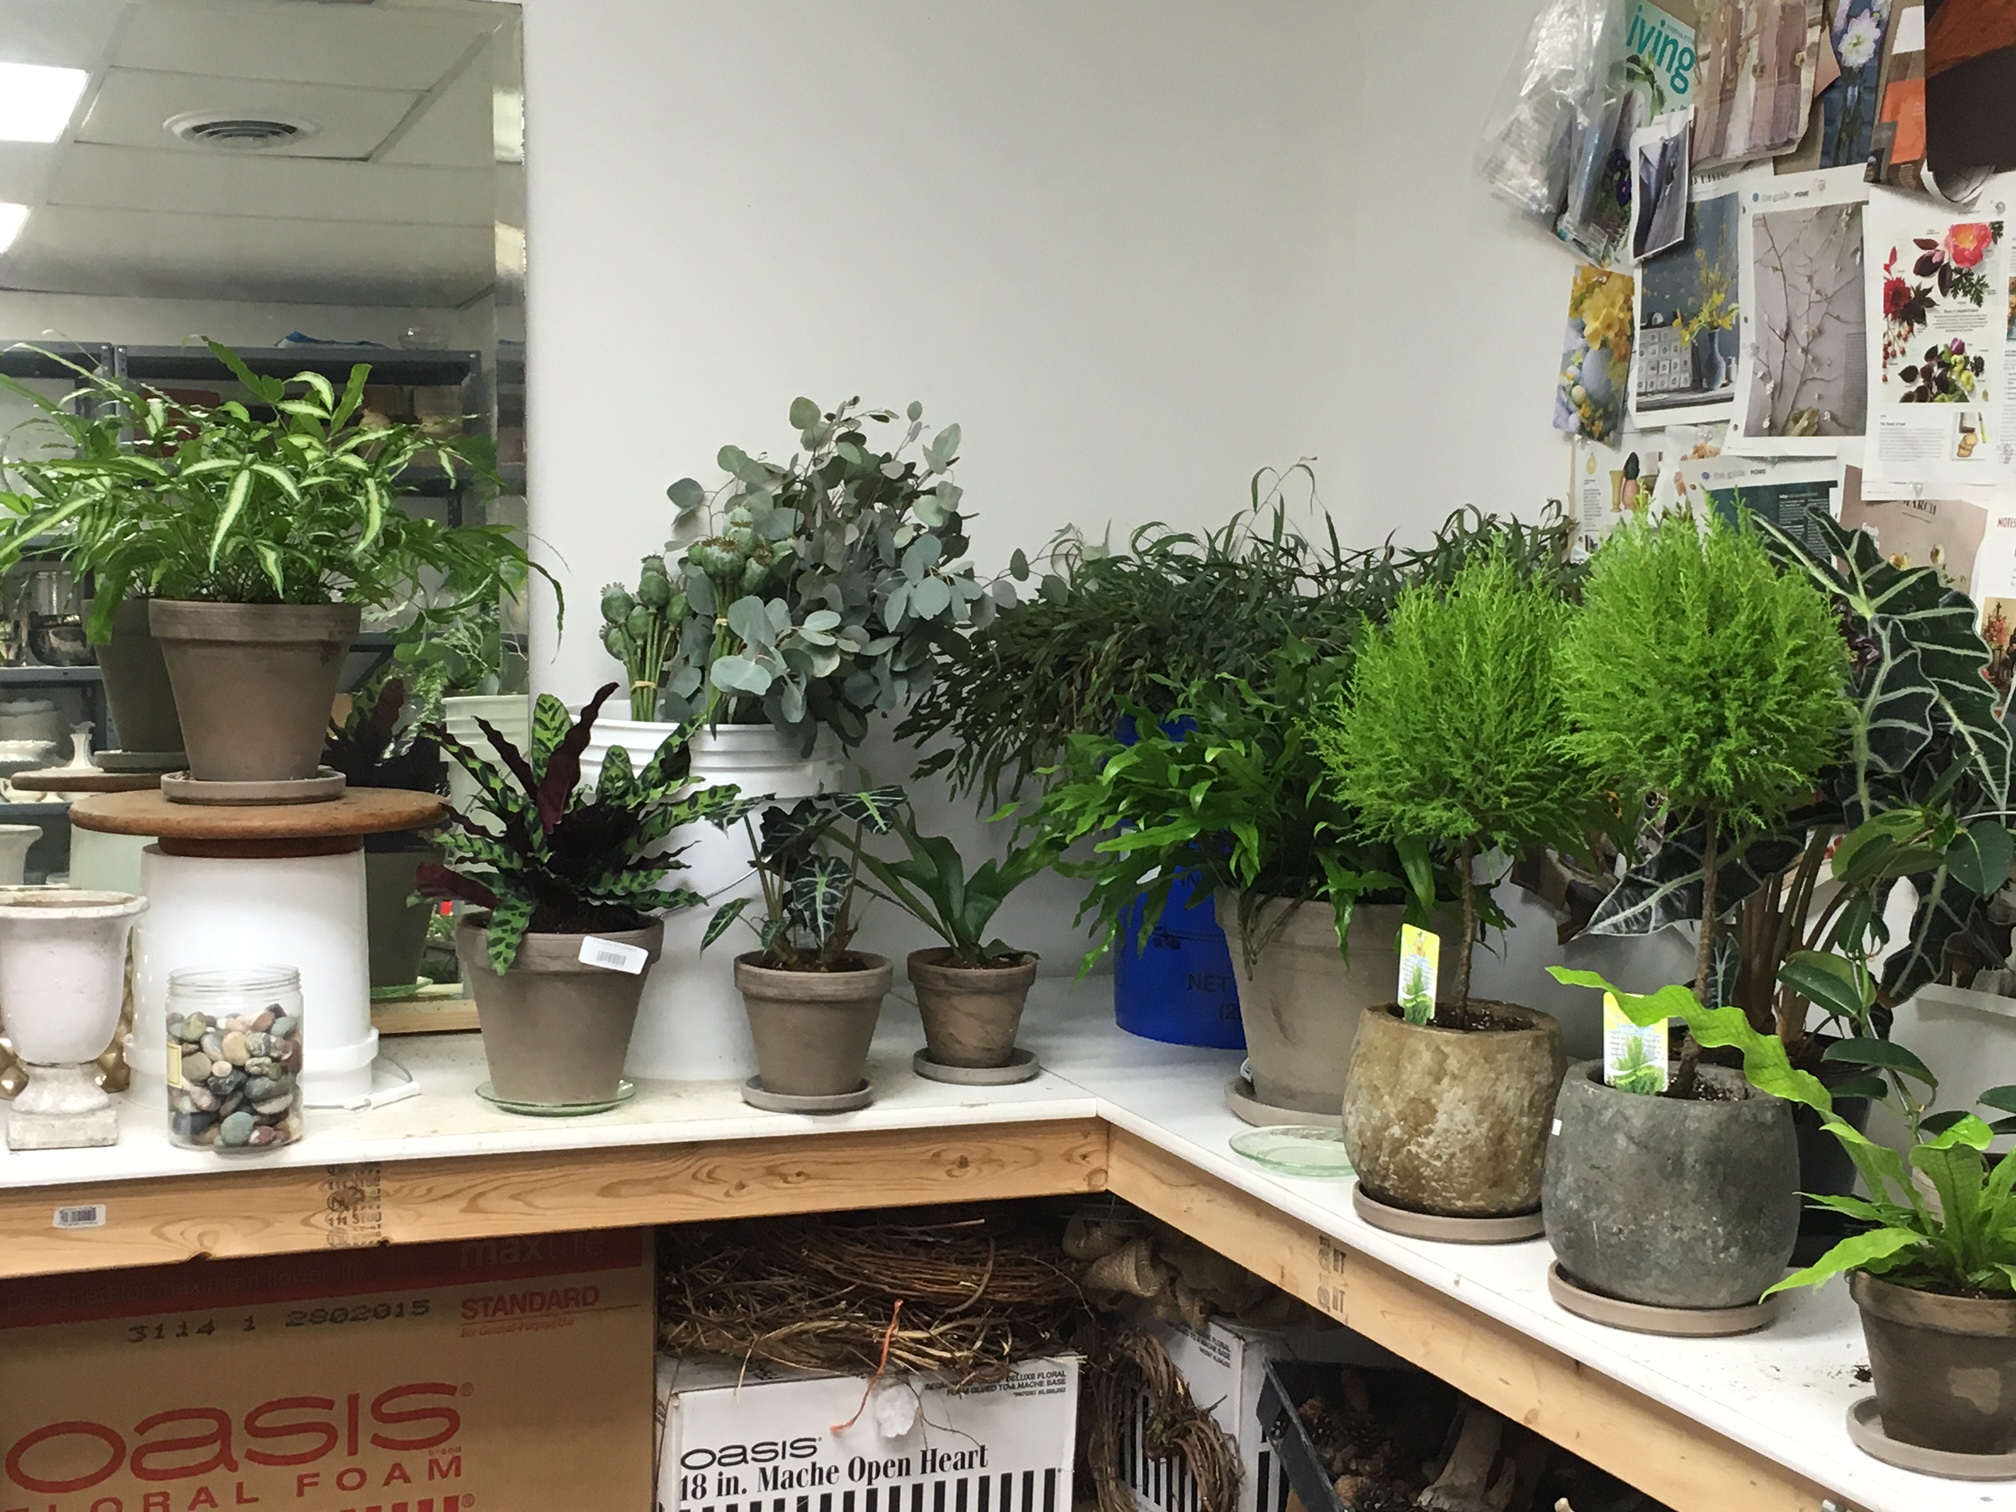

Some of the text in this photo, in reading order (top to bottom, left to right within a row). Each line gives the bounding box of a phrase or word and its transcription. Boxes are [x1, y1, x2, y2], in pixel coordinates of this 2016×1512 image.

[460, 1285, 600, 1320] STANDARD
[126, 1318, 217, 1343] 3114
[243, 1315, 256, 1332] 1
[1017, 1380, 1044, 1389] MACHE
[1046, 1378, 1066, 1387] BASE
[1037, 1370, 1067, 1380] FLORAL
[429, 1446, 462, 1457] brand
[4, 1455, 462, 1512] ORAL FOAM
[680, 1444, 988, 1502] 18 in. Mache Open Heart
